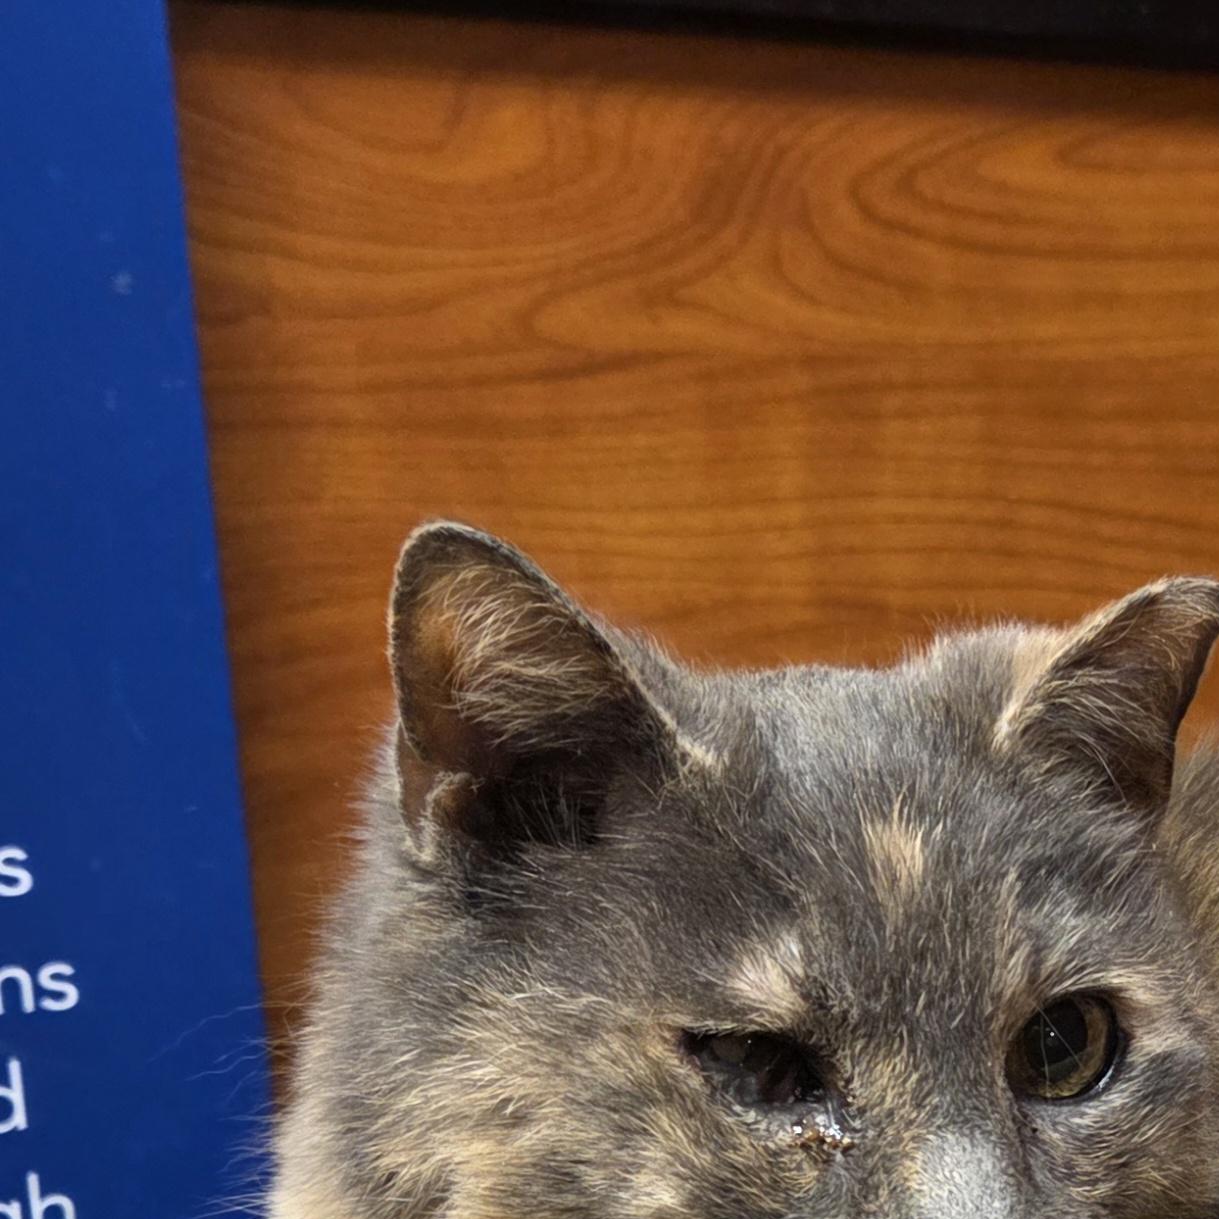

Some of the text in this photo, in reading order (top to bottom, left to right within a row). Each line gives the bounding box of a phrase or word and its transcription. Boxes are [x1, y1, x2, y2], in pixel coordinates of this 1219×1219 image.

[0, 846, 33, 897] s
[0, 962, 80, 1014] ns
[0, 1058, 28, 1134] d
